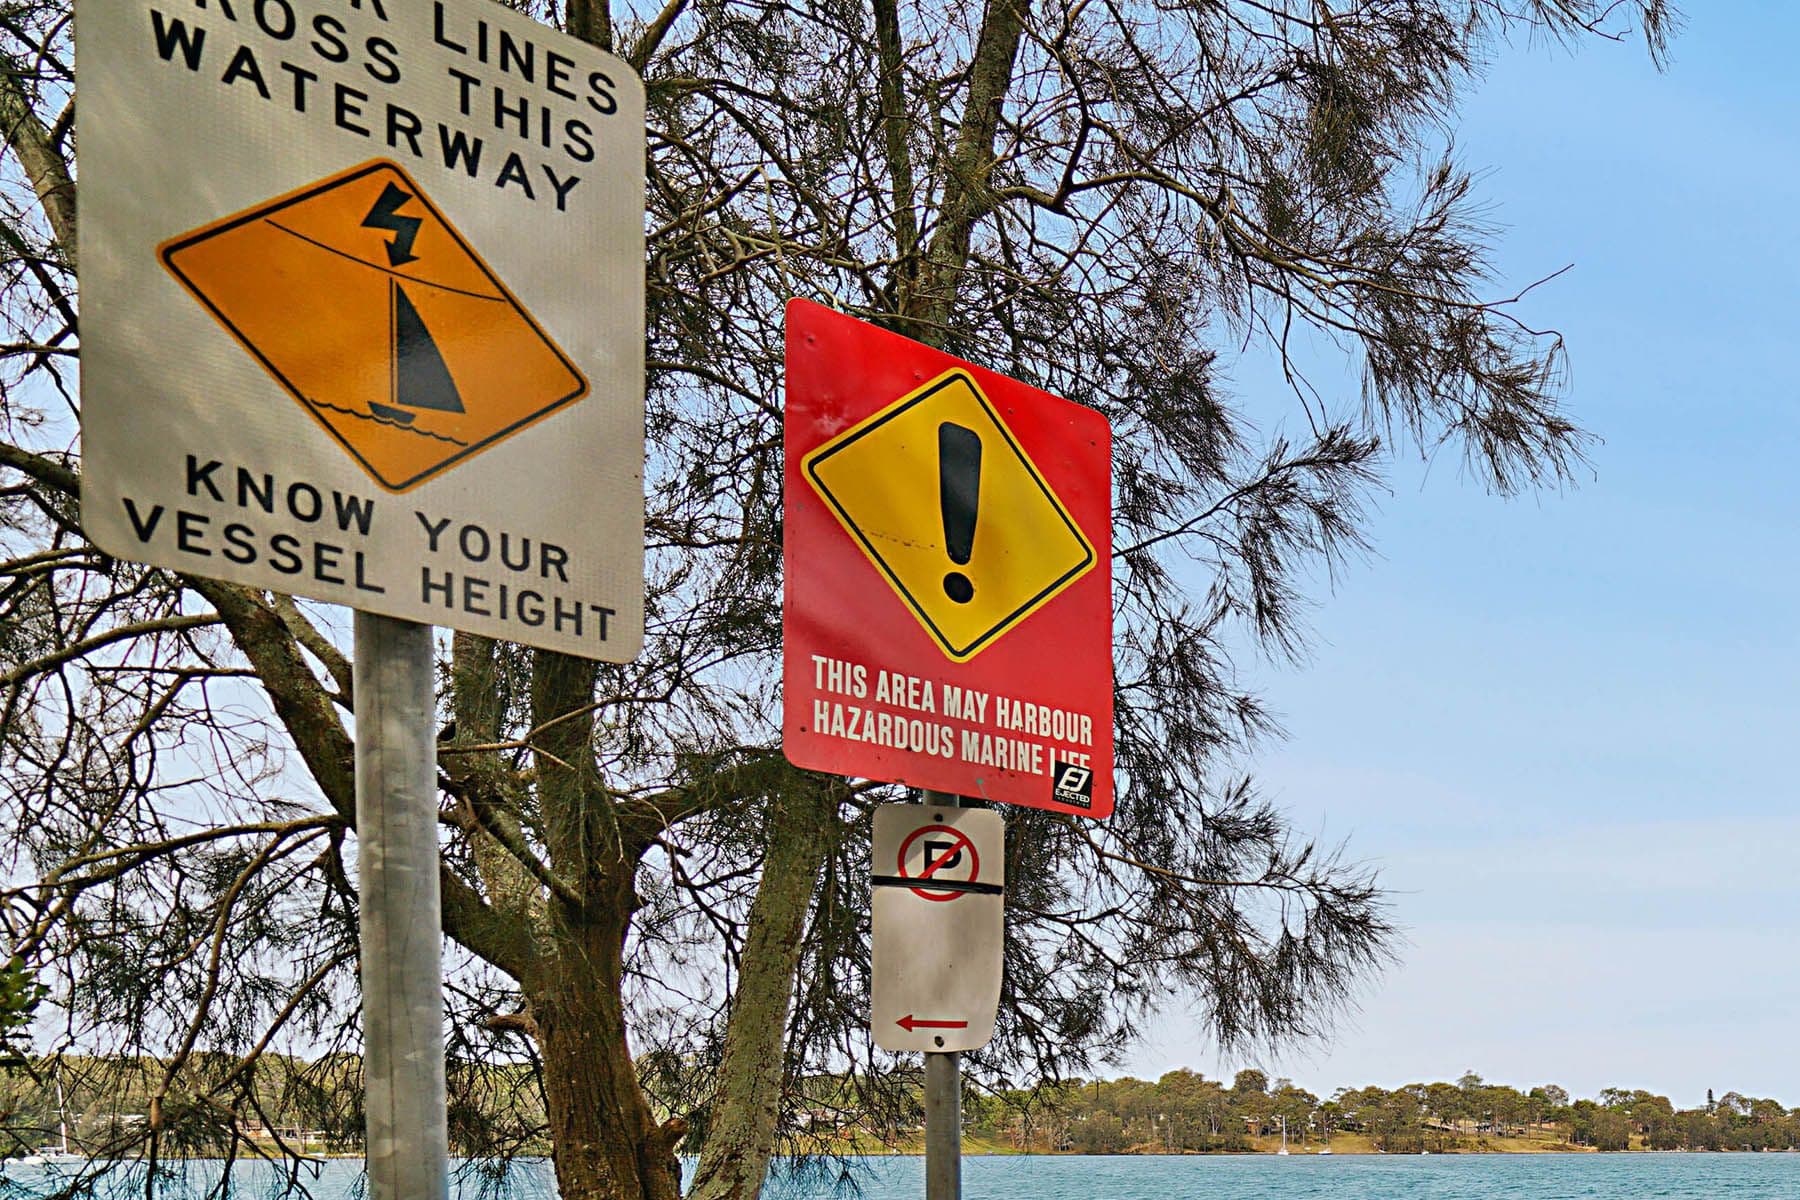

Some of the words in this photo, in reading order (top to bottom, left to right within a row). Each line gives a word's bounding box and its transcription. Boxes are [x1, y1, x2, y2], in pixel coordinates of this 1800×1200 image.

[150, 8, 581, 212] WATERWAY
[433, 1, 619, 116] LINES
[448, 67, 596, 163] THIS
[122, 497, 386, 595] VESSEL
[422, 567, 616, 642] HEIGHT
[187, 454, 375, 537] KNOW
[415, 511, 570, 584] YOUR
[811, 654, 868, 700] THIS
[875, 669, 936, 714] AREA
[943, 684, 990, 725] MAY
[996, 696, 1093, 746] HARBOUR
[813, 699, 954, 759] HAZARDOUS
[961, 730, 1043, 775] MARINE
